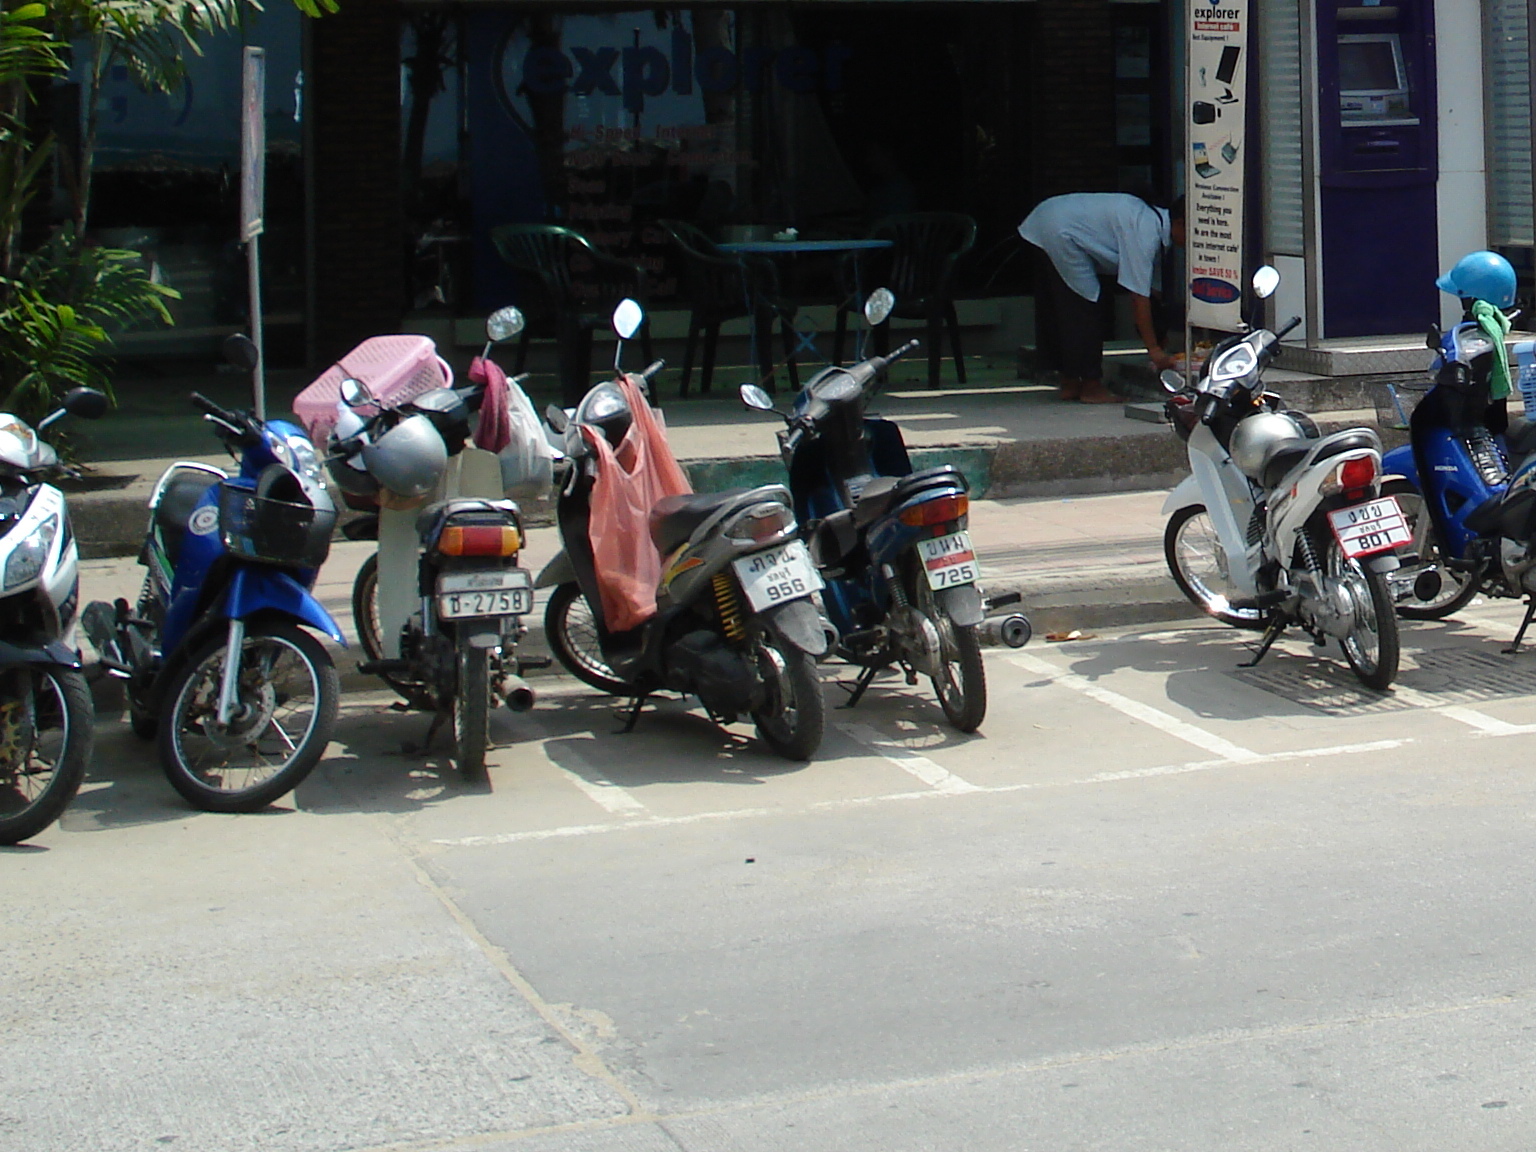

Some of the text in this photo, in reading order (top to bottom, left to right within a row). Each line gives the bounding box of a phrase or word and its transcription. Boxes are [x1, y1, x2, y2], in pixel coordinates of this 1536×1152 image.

[1194, 6, 1240, 22] explorer
[1358, 531, 1392, 550] 801
[934, 565, 974, 586] 725
[766, 578, 805, 601] 956
